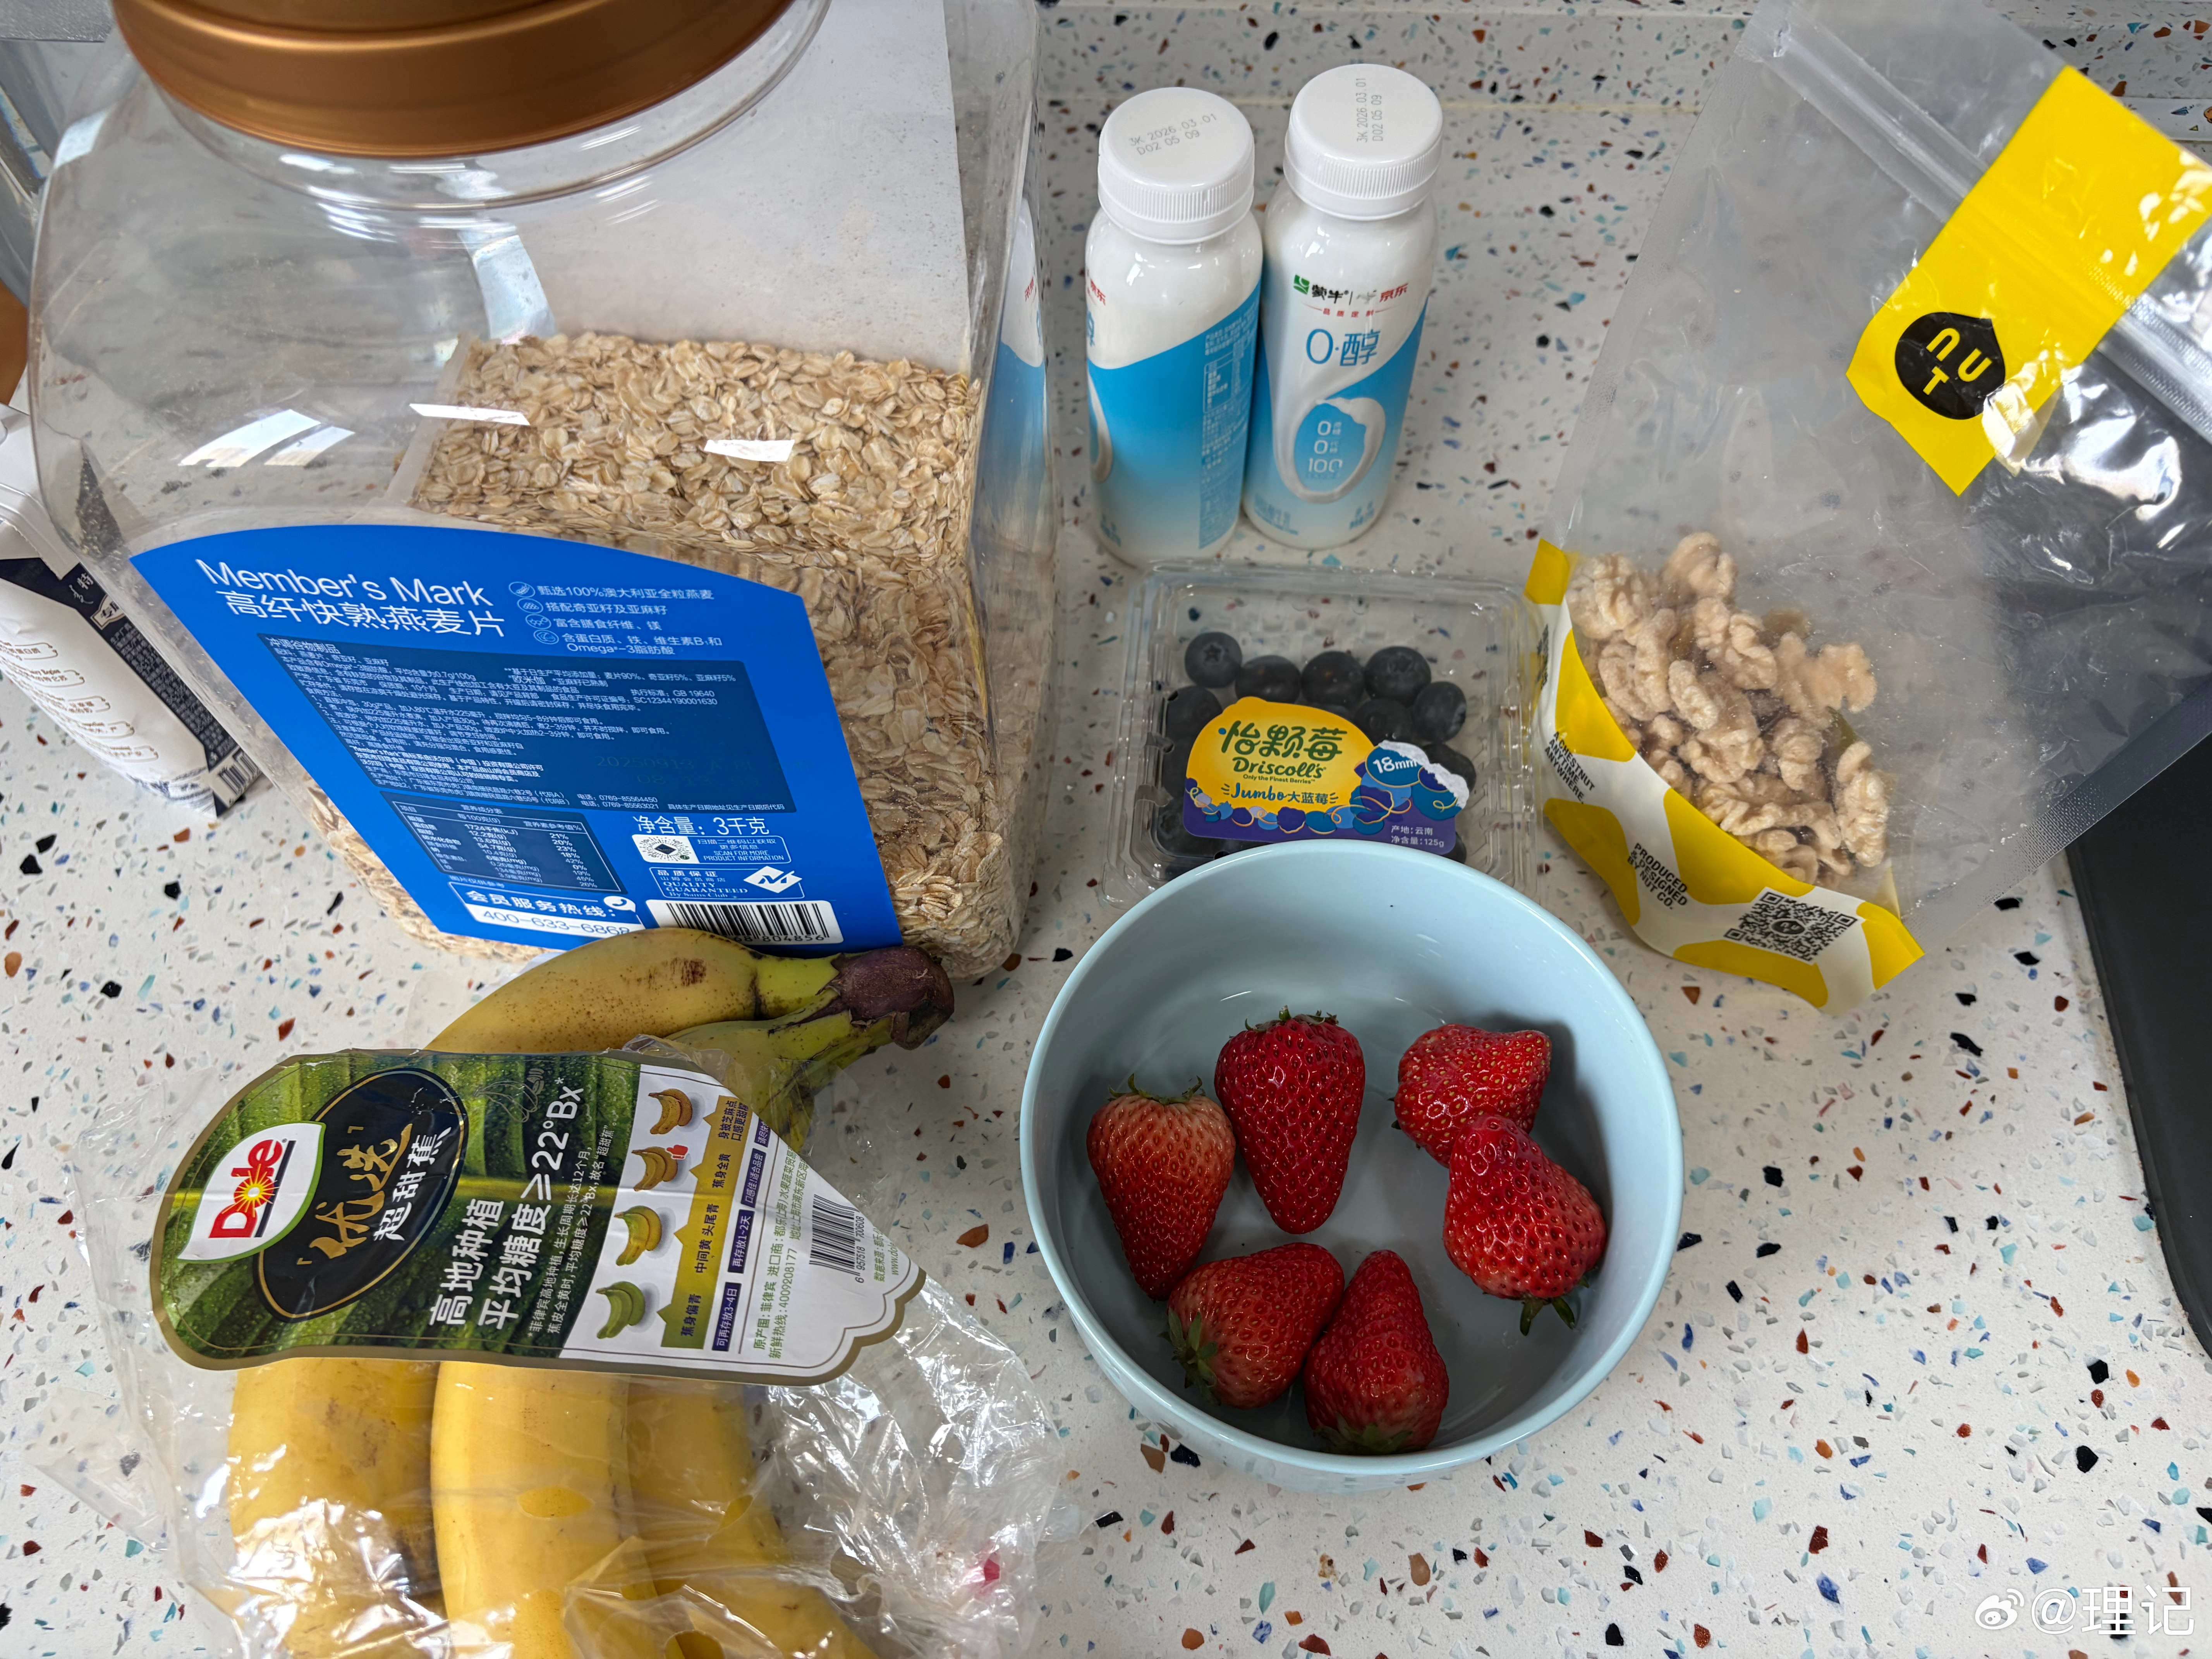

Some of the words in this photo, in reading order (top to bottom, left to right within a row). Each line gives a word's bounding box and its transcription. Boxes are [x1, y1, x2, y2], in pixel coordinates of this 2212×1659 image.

[1356, 79, 1367, 127] 2026.03.01
[1371, 95, 1381, 105] 09
[1185, 130, 1200, 139] 09
[1379, 283, 1408, 302] 京东
[195, 559, 387, 601] Member's
[389, 577, 494, 606] Mark
[537, 586, 714, 599] 甄选100%澳大利亚全粒燕麦
[216, 590, 505, 637] 高纤快熟燕麦片
[545, 603, 668, 615] 搭配奇亚籽及亚麻籽
[553, 618, 662, 630] 富含膳食纤维、镁
[264, 637, 341, 654] 冲调谷物制品
[1218, 720, 1347, 761] 怡颗莓
[1232, 756, 1323, 779] Driscoll's
[1549, 739, 1579, 784] ANYTIME
[1558, 738, 1595, 792] CHESTNUT
[577, 793, 658, 802] 电话：0769-85564450
[1231, 782, 1287, 801] Jumbo
[1287, 791, 1329, 805] 大蓝莓
[633, 815, 769, 835] 净含量：3千克
[1627, 855, 1640, 871] BY
[1640, 871, 1658, 892] NUT
[1657, 891, 1674, 910] CO.
[1634, 843, 1688, 893] PRODUCED
[1637, 859, 1688, 907] DESIGNED
[466, 890, 616, 917] 会员服务热线：
[374, 1127, 452, 1242] 超甜蕉
[712, 1153, 731, 1188] 蕉身全黄
[208, 1139, 284, 1239] Dole
[702, 1204, 719, 1236] 头尾青
[694, 1239, 712, 1273] 中间黄
[732, 1215, 751, 1267] 再存放1~2天
[856, 1245, 866, 1271] 957518
[429, 1198, 504, 1326] 高地种植
[681, 1293, 701, 1336] 蕉身偏青
